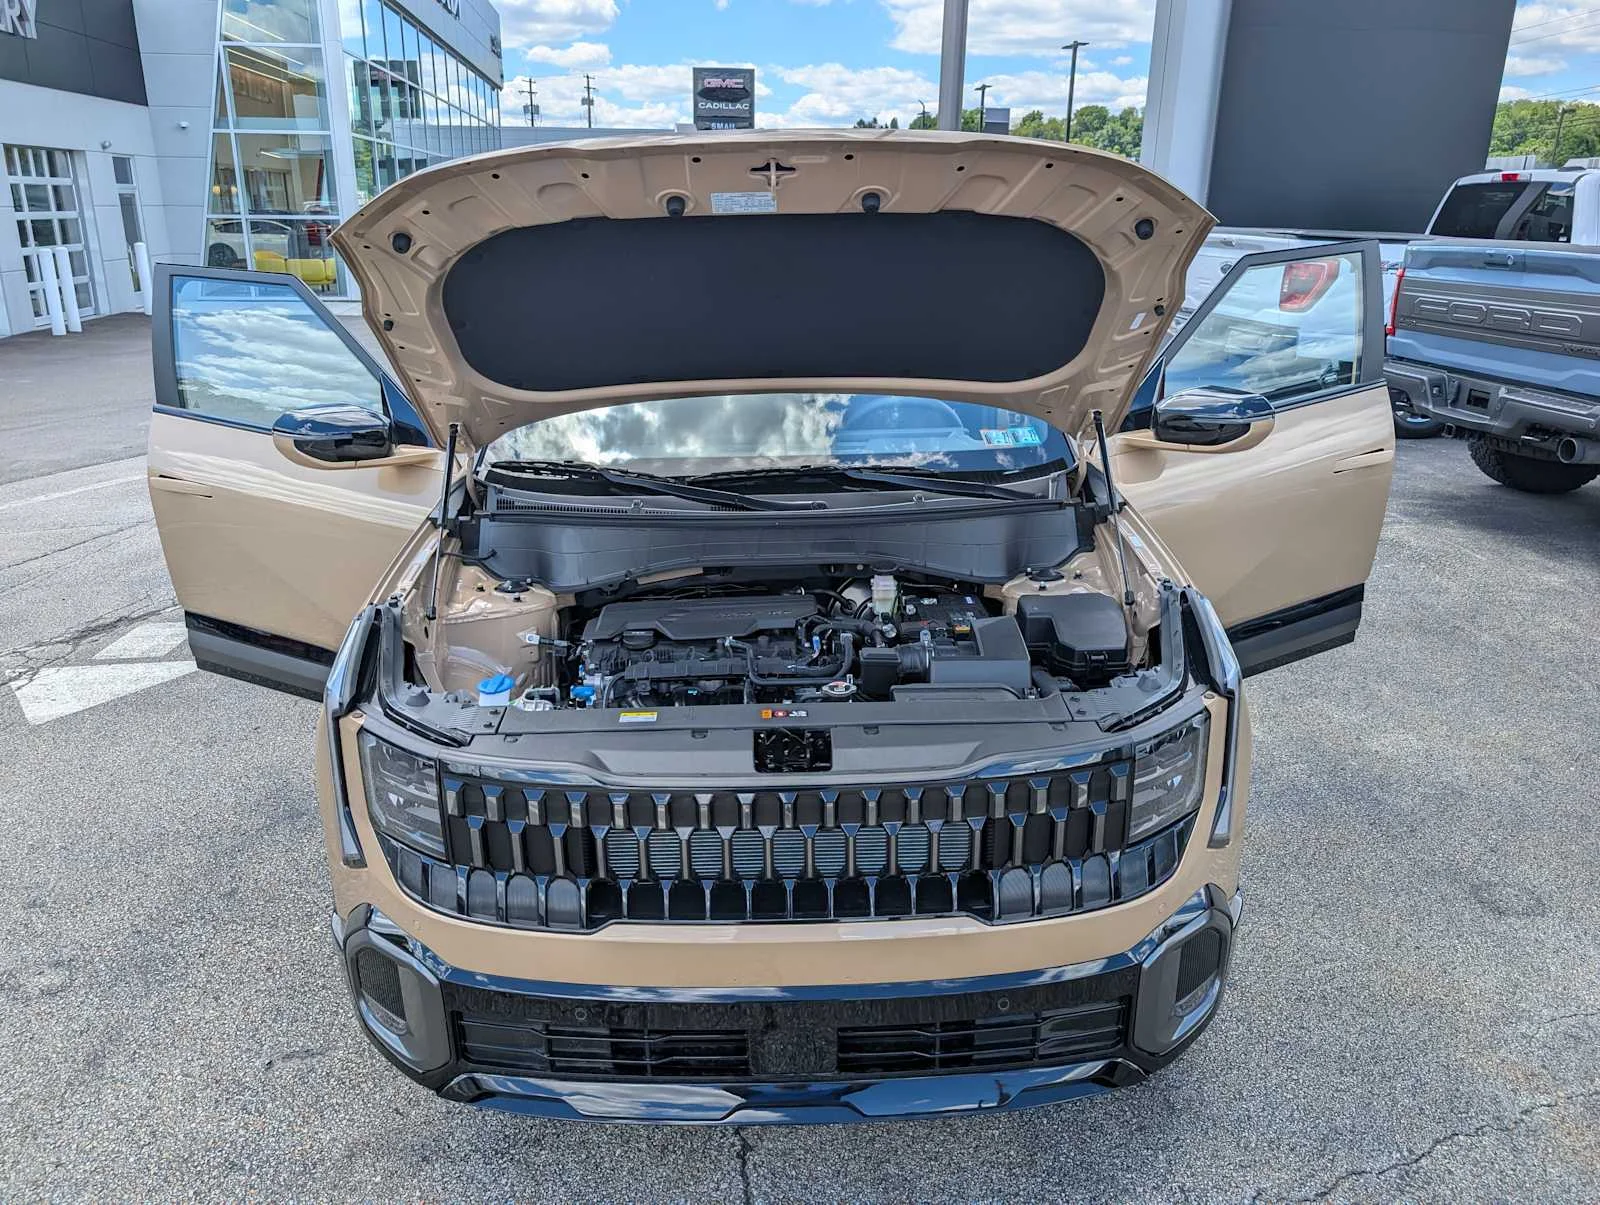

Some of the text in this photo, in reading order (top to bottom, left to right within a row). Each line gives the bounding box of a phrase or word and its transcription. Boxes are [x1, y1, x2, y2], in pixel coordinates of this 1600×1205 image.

[704, 79, 744, 88] GMC
[698, 102, 749, 110] CADILLAC
[1414, 297, 1583, 337] FORD
